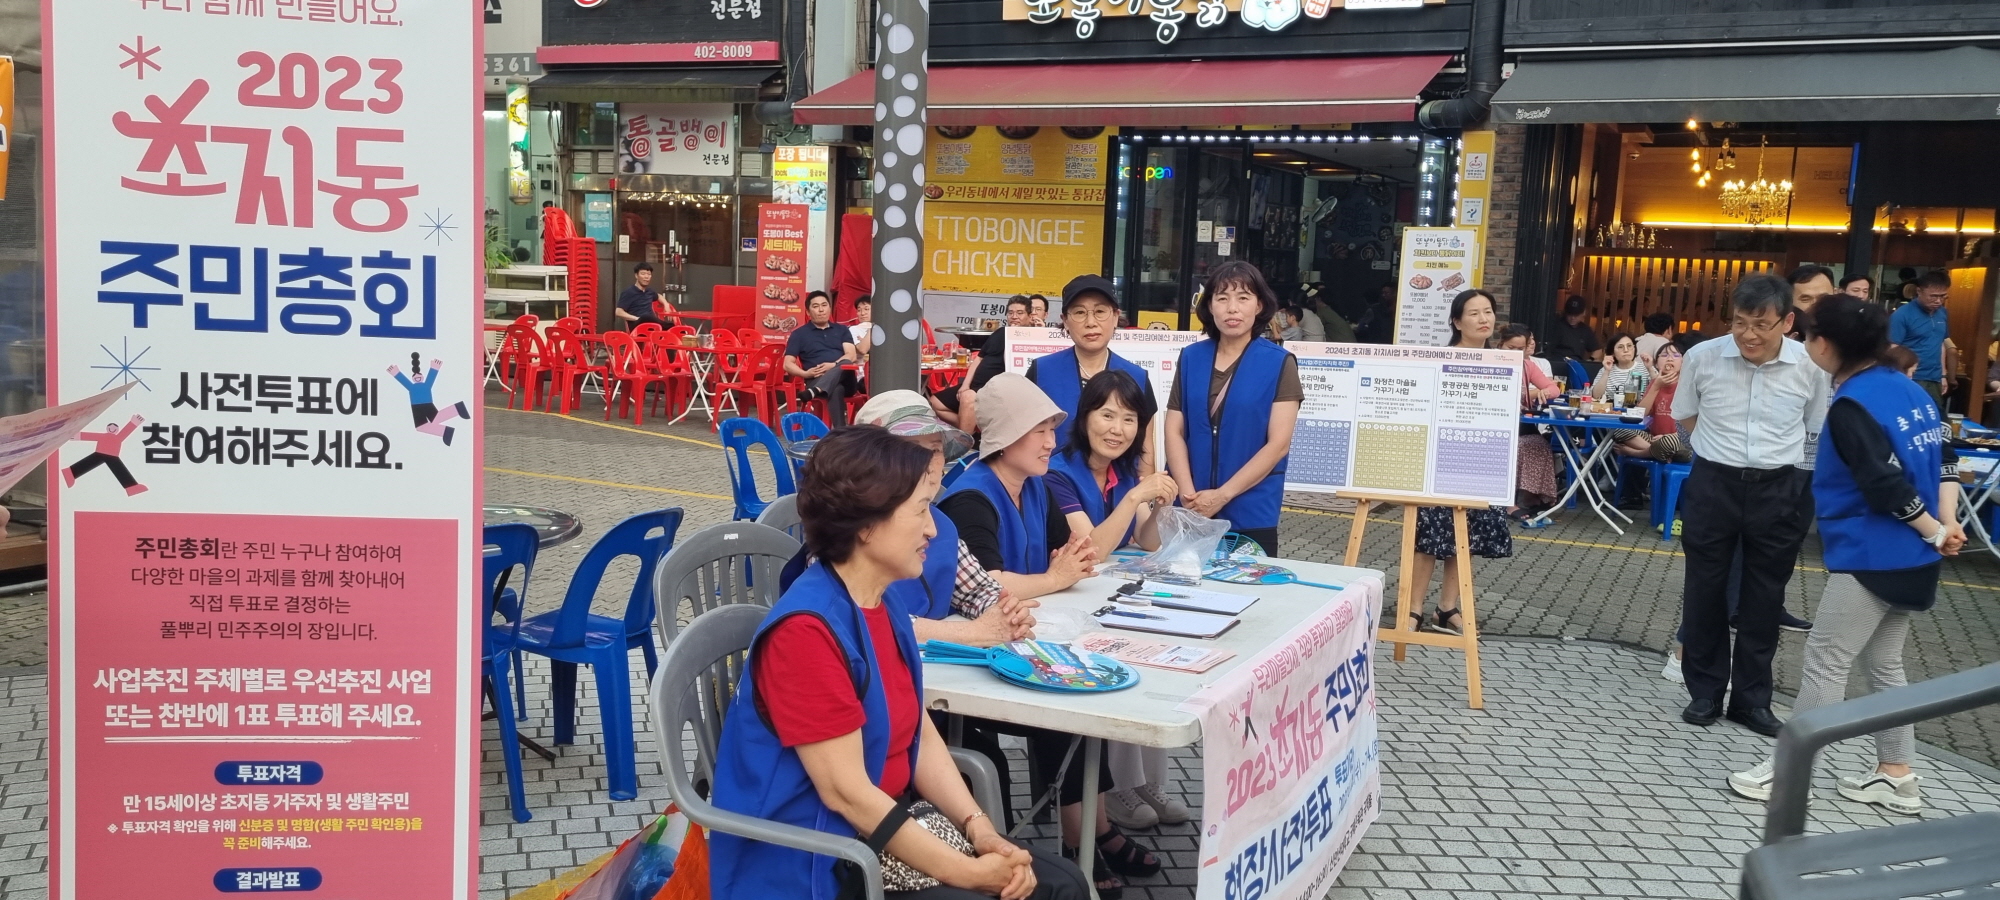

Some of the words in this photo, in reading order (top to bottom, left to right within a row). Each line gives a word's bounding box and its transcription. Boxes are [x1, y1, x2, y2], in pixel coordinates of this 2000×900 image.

[711, 0, 761, 20] 전문점
[694, 45, 752, 58] 402-8009
[237, 50, 403, 114] 2023
[112, 78, 420, 233] 초지동
[1065, 143, 1097, 155] 고추통닭
[703, 153, 730, 166] 전문점
[945, 185, 1010, 199] 우리동네에서
[1012, 186, 1034, 200] 제일
[1035, 187, 1069, 201] 맛있는
[1072, 188, 1107, 202] 통닭집
[785, 229, 804, 238] Best
[933, 215, 1085, 246] TTOBONGEE
[763, 239, 803, 252] 세트메뉴
[932, 250, 1035, 279] CHICKEN
[97, 240, 437, 340] 주민총회
[1325, 347, 1350, 355] 2024년
[1403, 349, 1410, 357] 및
[1411, 350, 1453, 360] 주민참여예산
[1454, 352, 1483, 361] 제안사업
[1373, 378, 1394, 386] 화정천
[1396, 378, 1417, 387] 마을길
[1373, 386, 1394, 395] 가꾸기
[1395, 387, 1409, 395] 사업
[1471, 382, 1500, 391] 정원개선
[1501, 384, 1509, 392] 및
[170, 371, 378, 416] 사전투표에
[1440, 390, 1462, 398] 가꾸기
[1463, 391, 1478, 399] 사업
[142, 422, 403, 470] 참여해주세요.
[135, 537, 238, 560] 주민총회란
[242, 542, 276, 560] 주민
[280, 542, 331, 562] 누구나
[335, 543, 401, 563] 참여하여
[131, 567, 184, 586] 다양한
[189, 567, 240, 586] 마을의
[245, 568, 297, 587] 과제를
[301, 570, 334, 588] 함께
[338, 570, 405, 590] 찾아내어
[189, 594, 223, 613] 직접
[228, 595, 280, 613] 투표로
[284, 595, 351, 614] 결정하는
[160, 621, 212, 639] 풀뿌리
[218, 621, 302, 640] 민주주의의
[307, 622, 378, 641] 장입니다.
[1295, 632, 1313, 660] 직접
[1308, 616, 1335, 651] 투표하고
[93, 667, 188, 693] 사업추진
[194, 667, 287, 693] 주체별로
[292, 668, 382, 694] 우선추진
[386, 669, 431, 694] 사업
[104, 704, 153, 728] 또는
[158, 702, 228, 728] 찬반에
[234, 704, 270, 726] 1표
[274, 702, 342, 728] 투표해
[347, 703, 422, 729] 주세요.
[1226, 746, 1278, 818] 2023
[1270, 684, 1324, 781] 초지동
[236, 764, 302, 783] 투표자격
[123, 795, 141, 813] 만
[144, 793, 217, 813] 15세이상
[220, 793, 270, 812] 초지동
[273, 793, 322, 811] 거주자
[326, 793, 342, 811] 및
[345, 792, 410, 811] 생활주민
[121, 820, 171, 834] 투표자격
[173, 819, 210, 833] 확인을
[212, 819, 236, 833] 위해
[238, 818, 275, 833] 신분증
[276, 817, 288, 832] 및
[291, 817, 343, 833] 명함(생활
[345, 817, 369, 831] 주민
[371, 817, 423, 832] 확인용)을
[223, 837, 236, 850] 꼭
[237, 836, 312, 850] 준비해주세요.
[1224, 775, 1334, 900] 현장사전투표
[236, 871, 301, 889] 결과발표
